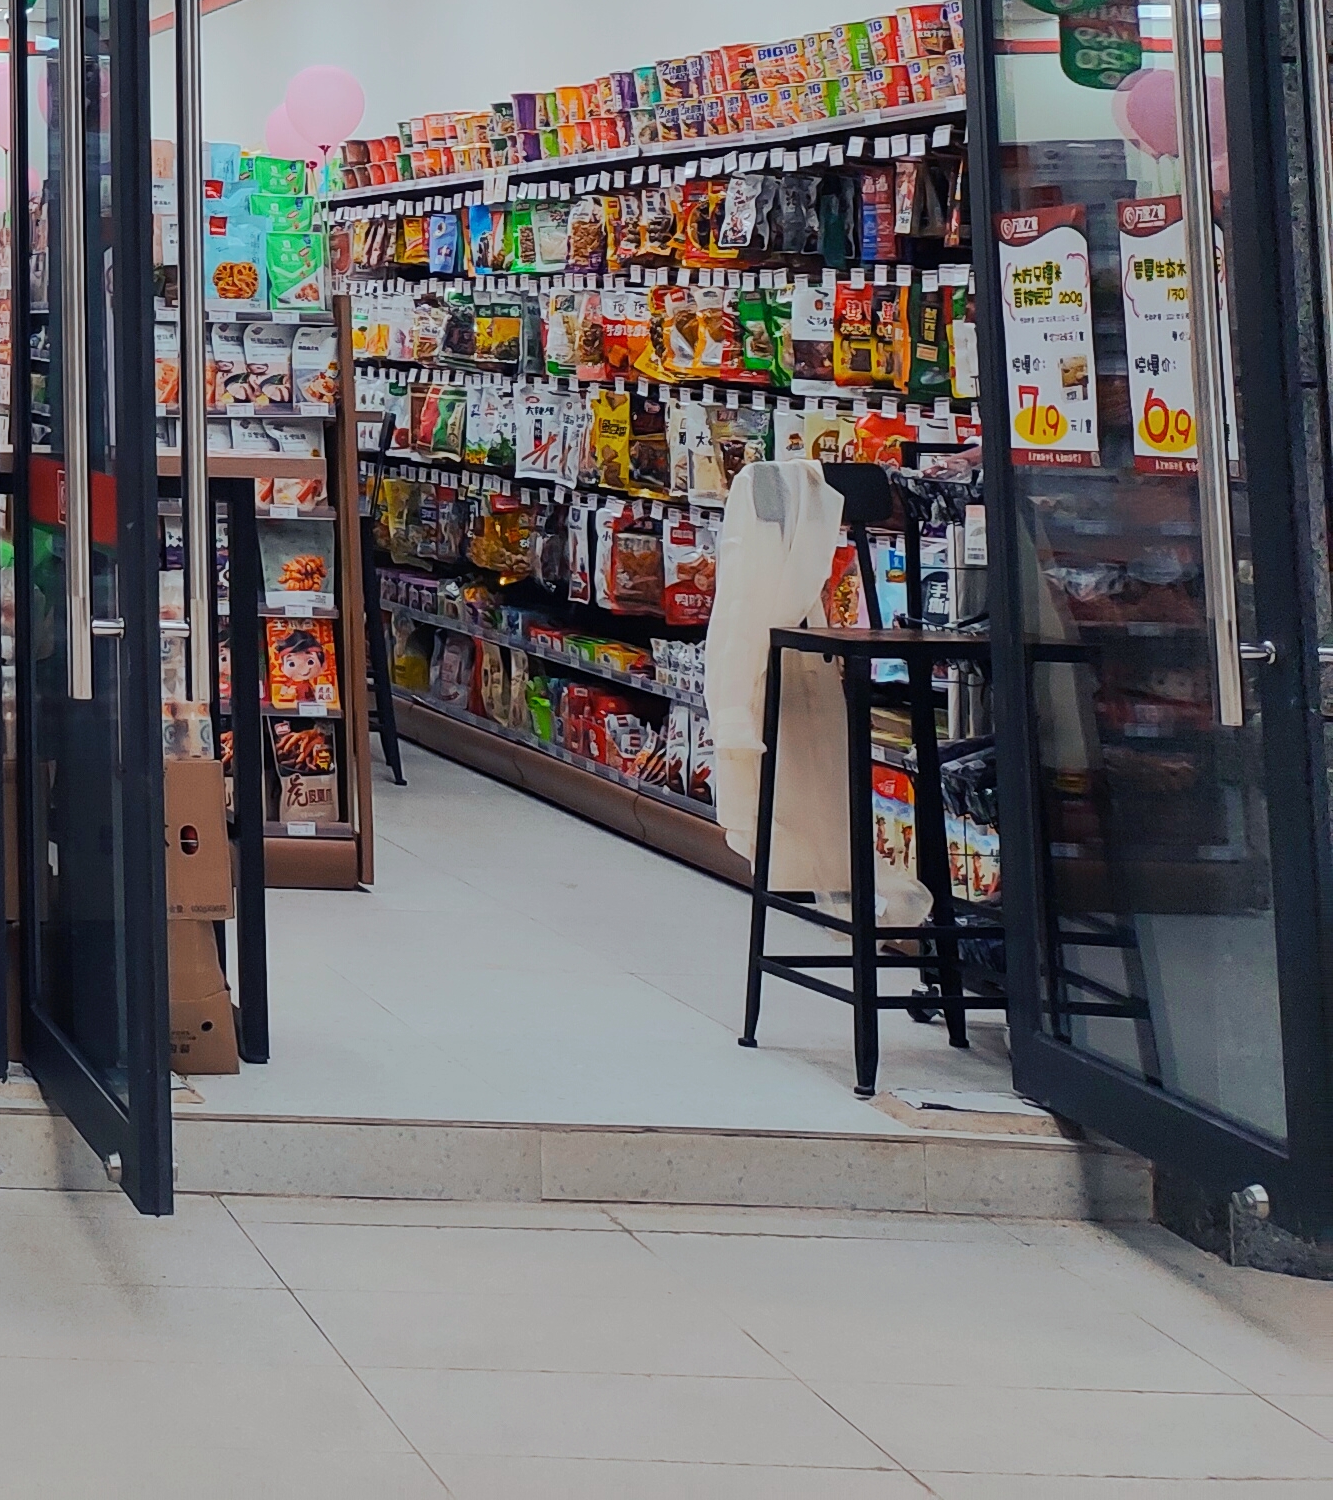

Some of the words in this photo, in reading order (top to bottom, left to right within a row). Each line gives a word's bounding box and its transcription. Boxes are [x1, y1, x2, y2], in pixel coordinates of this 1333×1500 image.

[758, 46, 783, 61] BIG
[1018, 385, 1059, 436] 7.9
[1144, 388, 1191, 444] 6.9
